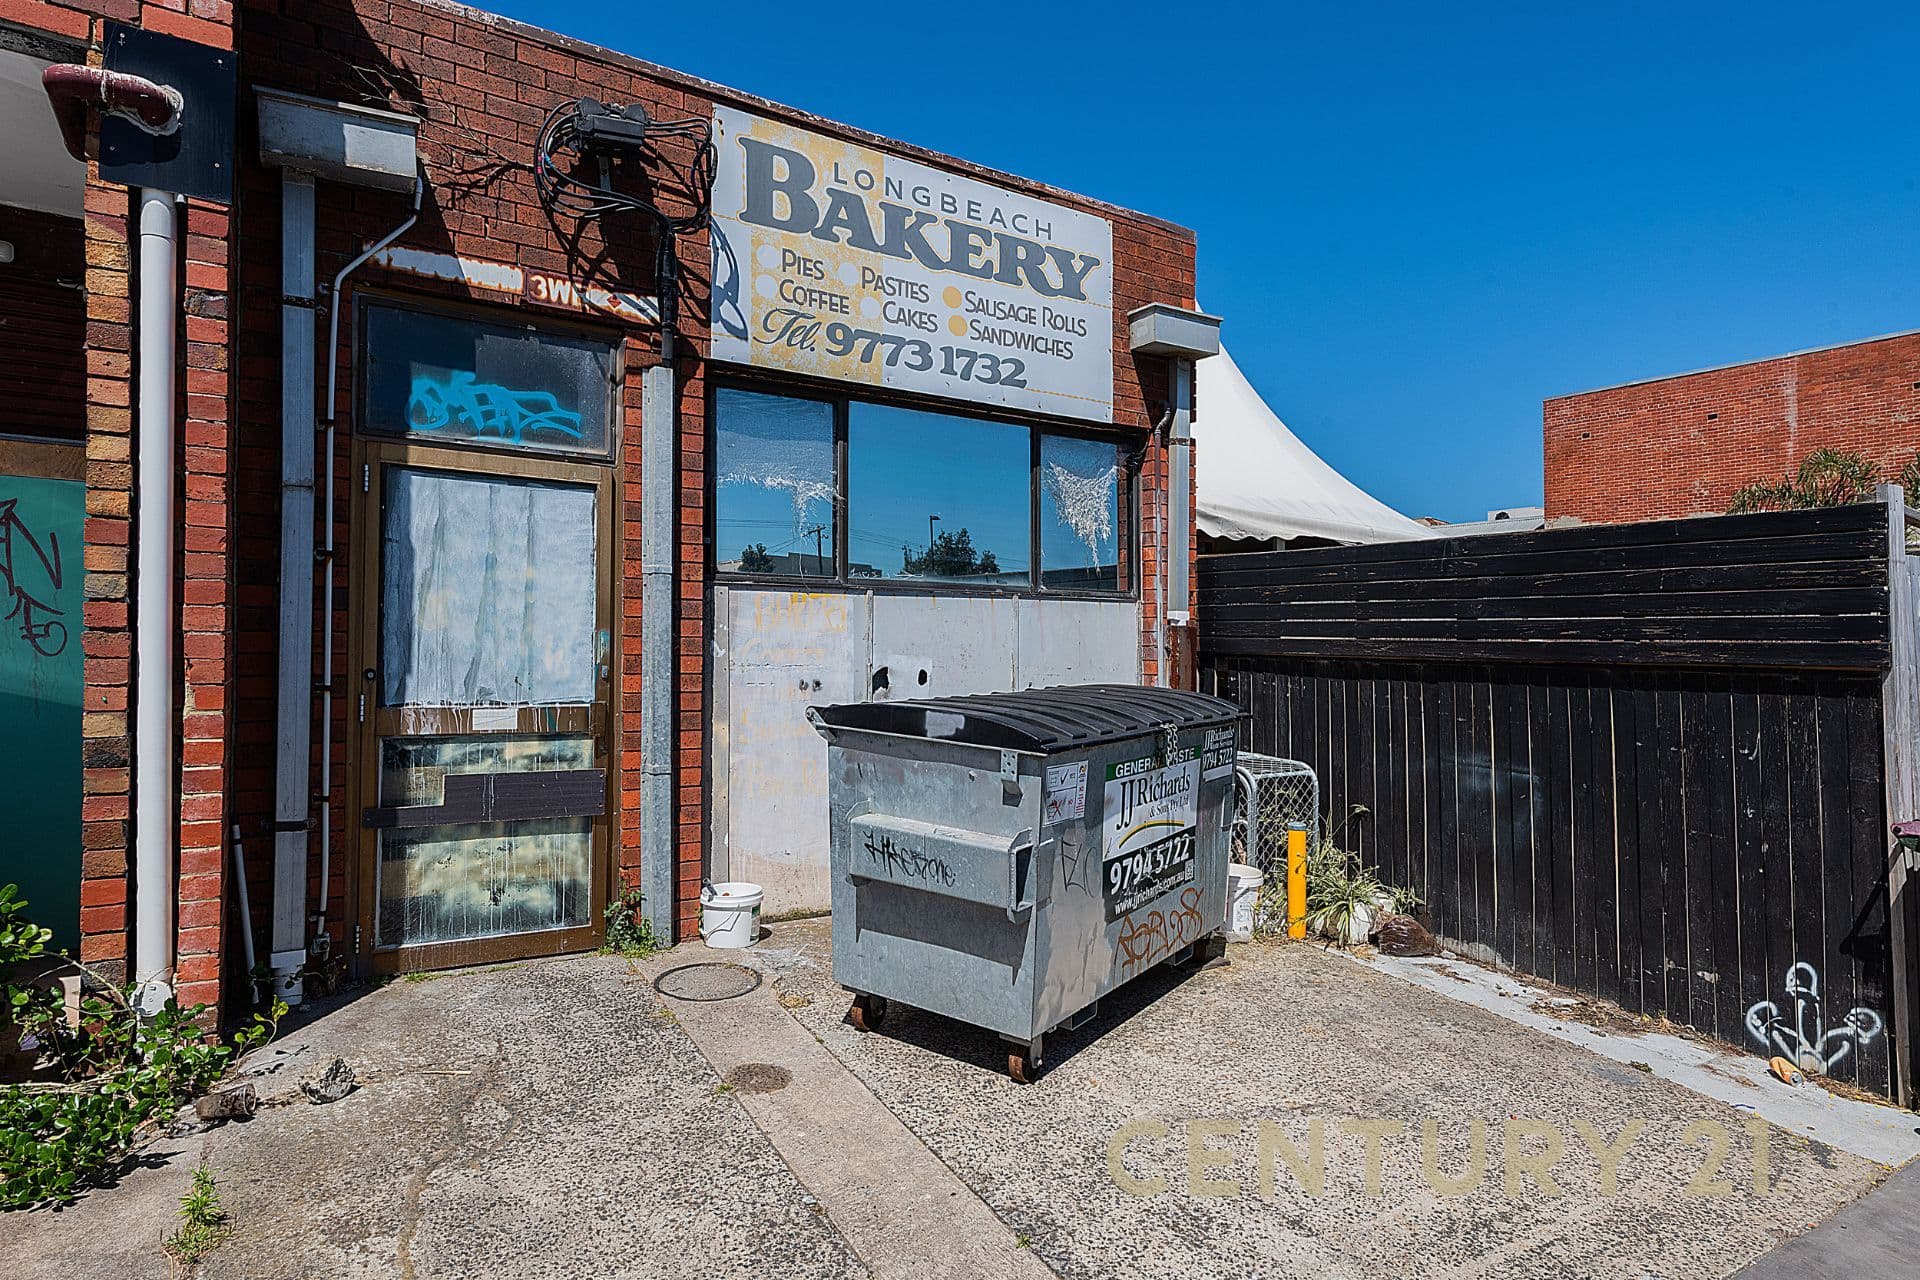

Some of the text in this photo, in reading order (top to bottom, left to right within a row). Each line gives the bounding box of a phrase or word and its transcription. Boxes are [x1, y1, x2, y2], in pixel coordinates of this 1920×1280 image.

[738, 137, 1101, 301] BAKERY
[834, 162, 1053, 240] LONGBEACH
[779, 279, 1074, 360] COFFEE CAKES SANDWICHES
[782, 248, 1087, 337] PIES PASTIES SAUSAGE ROLLS
[753, 308, 1028, 389] Tel. 9773 1732
[1110, 850, 1153, 895] 9794
[1156, 834, 1190, 874] 5722
